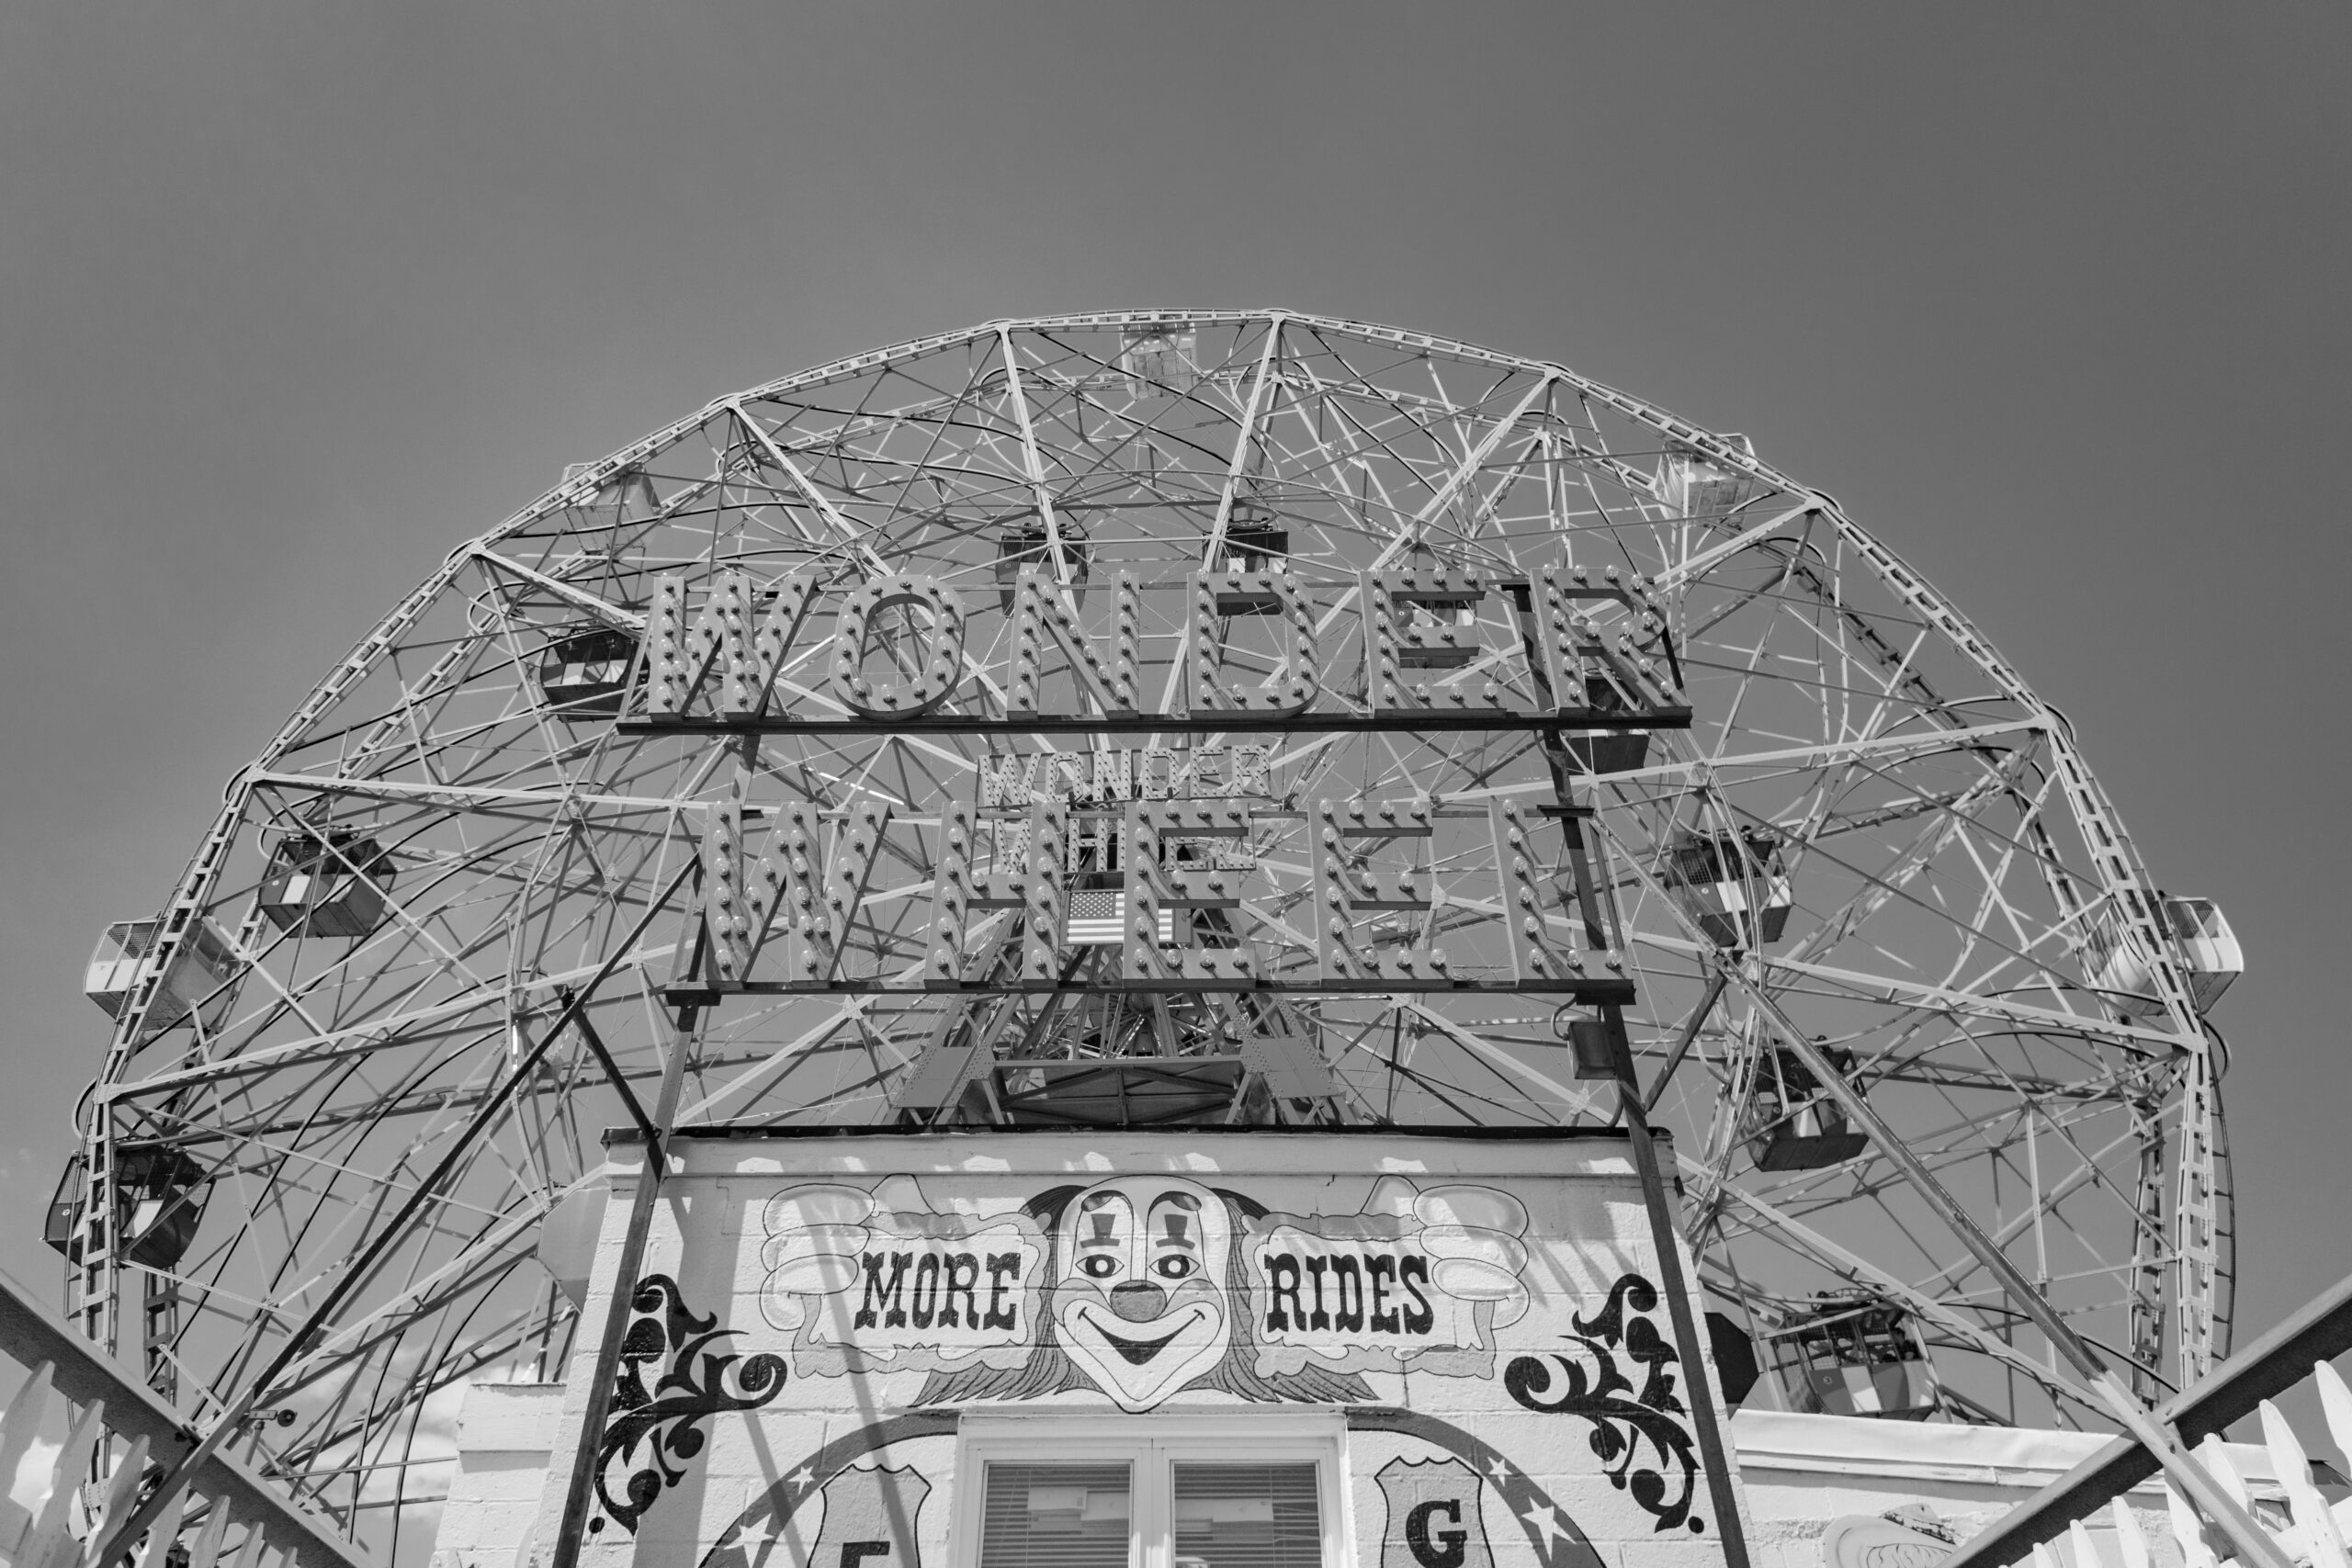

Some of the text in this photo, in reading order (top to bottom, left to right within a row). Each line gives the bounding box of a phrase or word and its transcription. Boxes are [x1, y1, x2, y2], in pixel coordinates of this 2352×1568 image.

[647, 567, 1692, 720] WONDER
[978, 744, 1272, 807] WONDER
[992, 817, 1257, 874] WHEL
[704, 799, 1634, 988] WHEEL
[853, 1251, 1435, 1336] MORE RIDES
[1405, 1498, 1468, 1568] G
